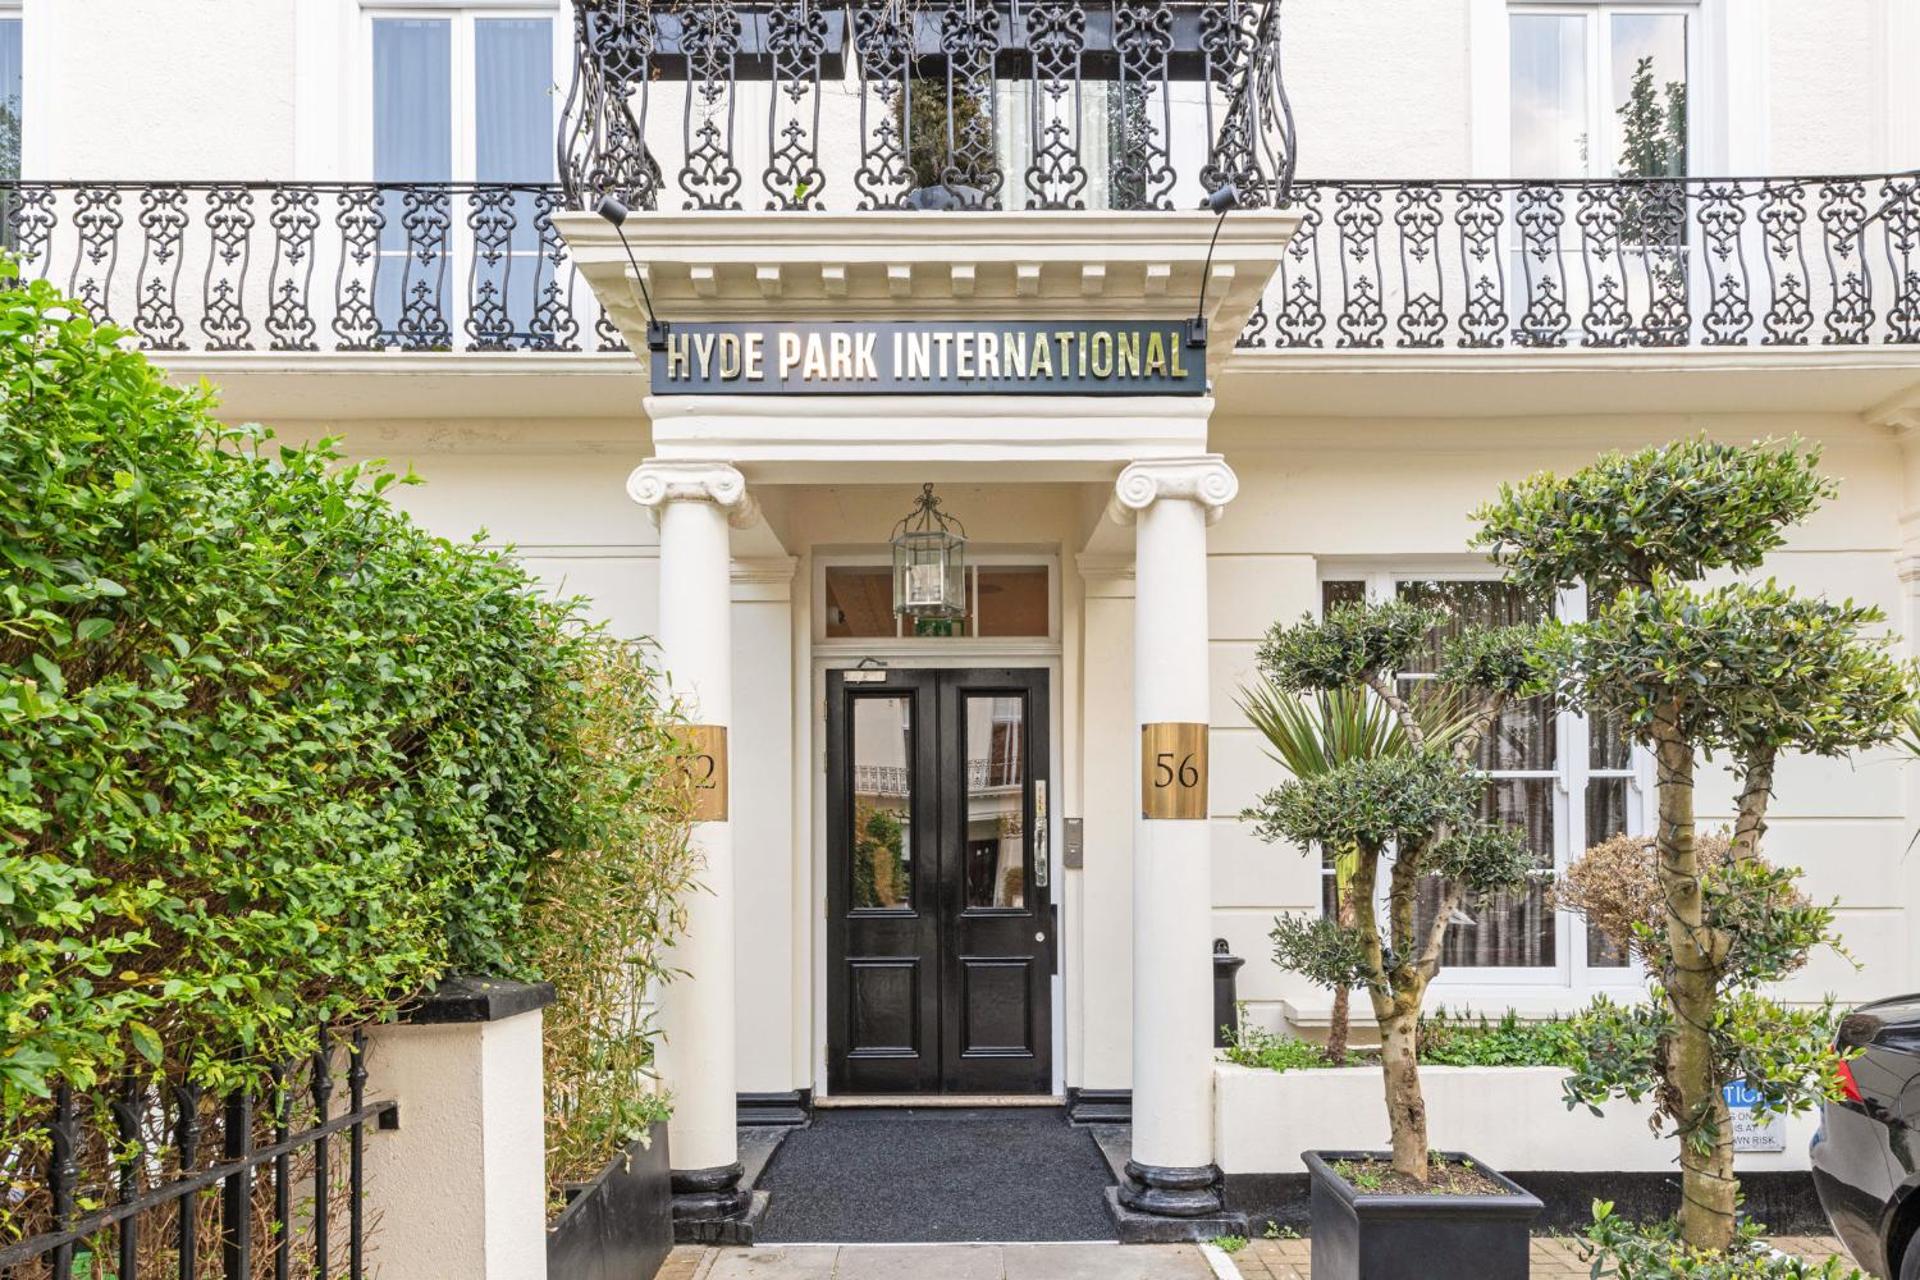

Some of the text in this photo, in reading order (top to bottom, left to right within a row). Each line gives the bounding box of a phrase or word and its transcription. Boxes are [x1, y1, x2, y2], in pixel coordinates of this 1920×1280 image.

[667, 331, 1189, 380] HYDE PARK INTERNATIONAL
[673, 754, 716, 790] 52
[1154, 752, 1199, 788] 56
[1723, 1086, 1763, 1104] TIC
[1752, 1135, 1777, 1145] RISK
